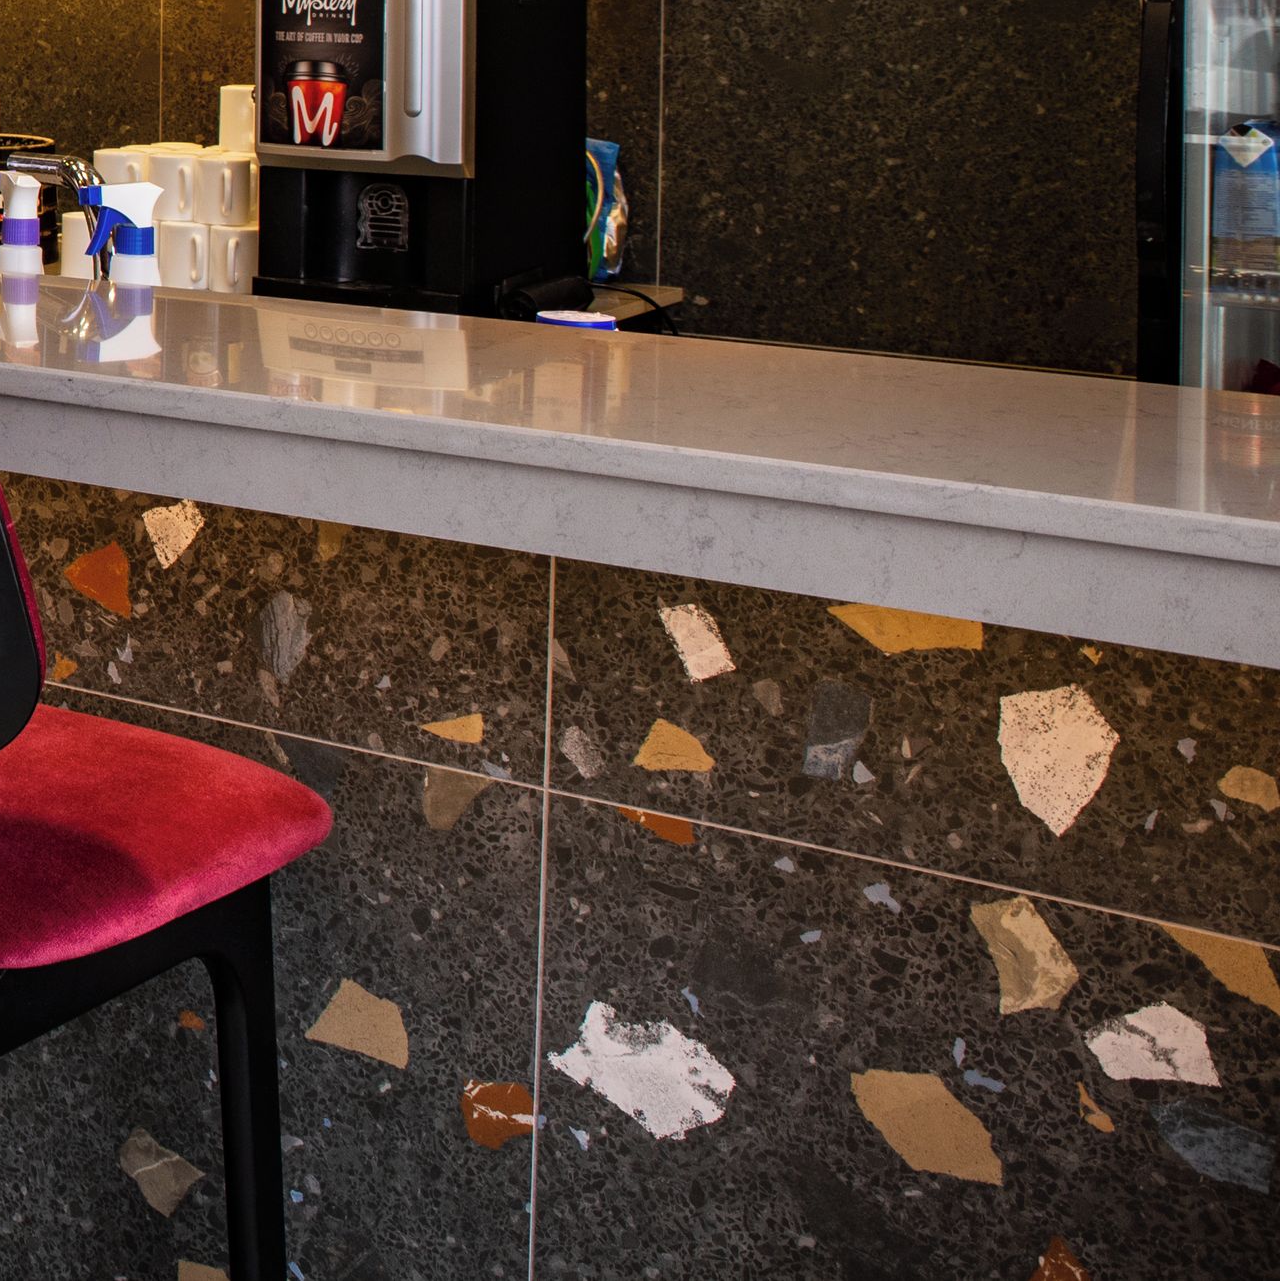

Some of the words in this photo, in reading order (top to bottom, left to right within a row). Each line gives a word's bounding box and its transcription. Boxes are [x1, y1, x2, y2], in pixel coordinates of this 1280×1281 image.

[297, 31, 304, 42] OF
[305, 31, 325, 43] COFFEE
[351, 33, 363, 43] CUP
[291, 85, 338, 146] M
